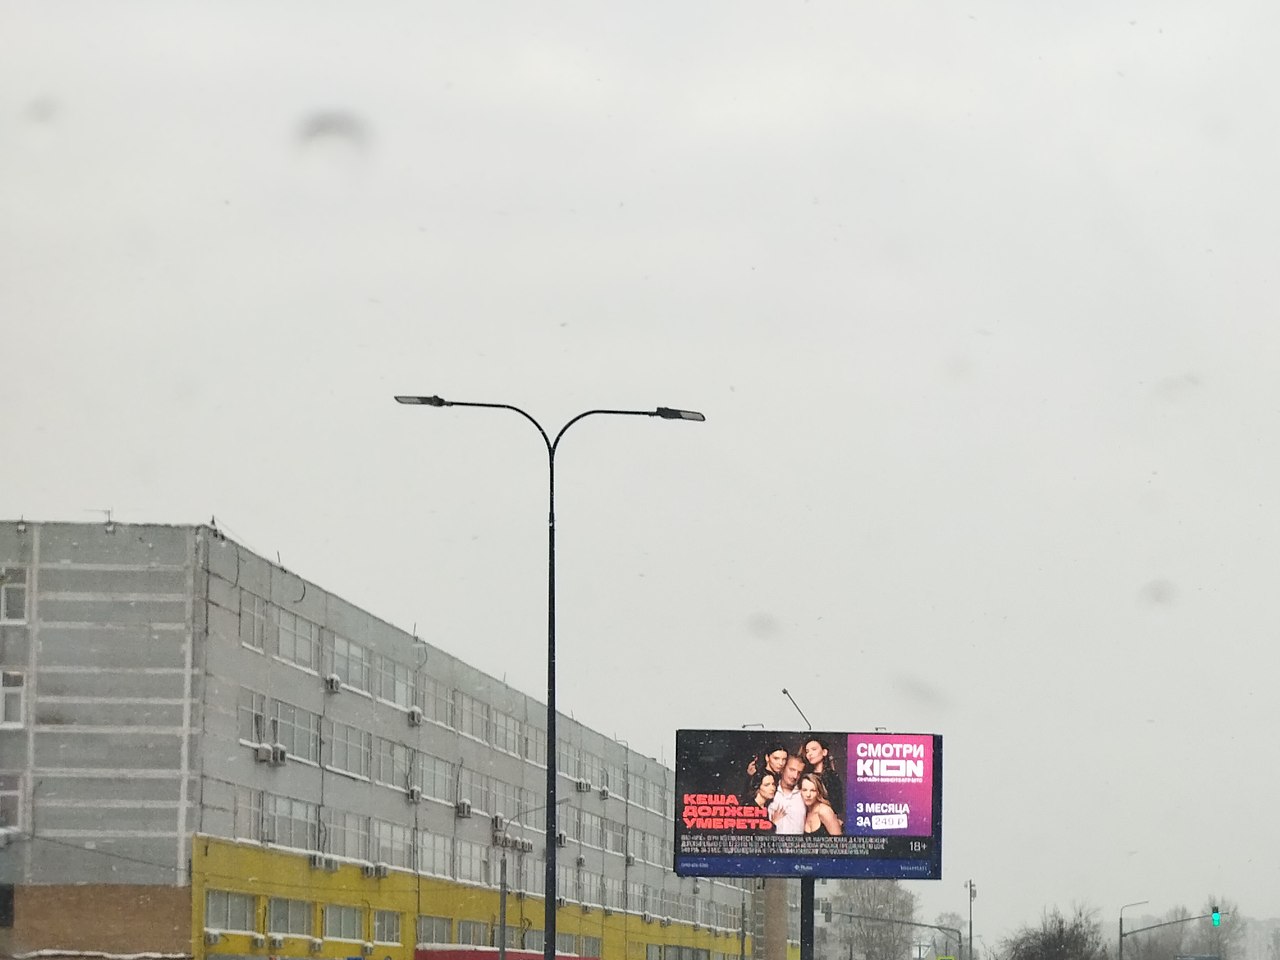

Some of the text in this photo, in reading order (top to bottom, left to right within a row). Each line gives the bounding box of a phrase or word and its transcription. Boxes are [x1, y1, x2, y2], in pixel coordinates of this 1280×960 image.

[857, 743, 925, 758] СМОТРИ
[857, 759, 924, 777] KION
[683, 793, 739, 805] КЕША
[683, 805, 768, 818] ДОЛЖЕН
[856, 803, 910, 814] 3 МЕСЯЦА
[683, 818, 773, 829] УМЕРЕТЬ
[856, 816, 871, 827] ЗА
[875, 816, 895, 826] 249
[909, 841, 928, 851] 18+
